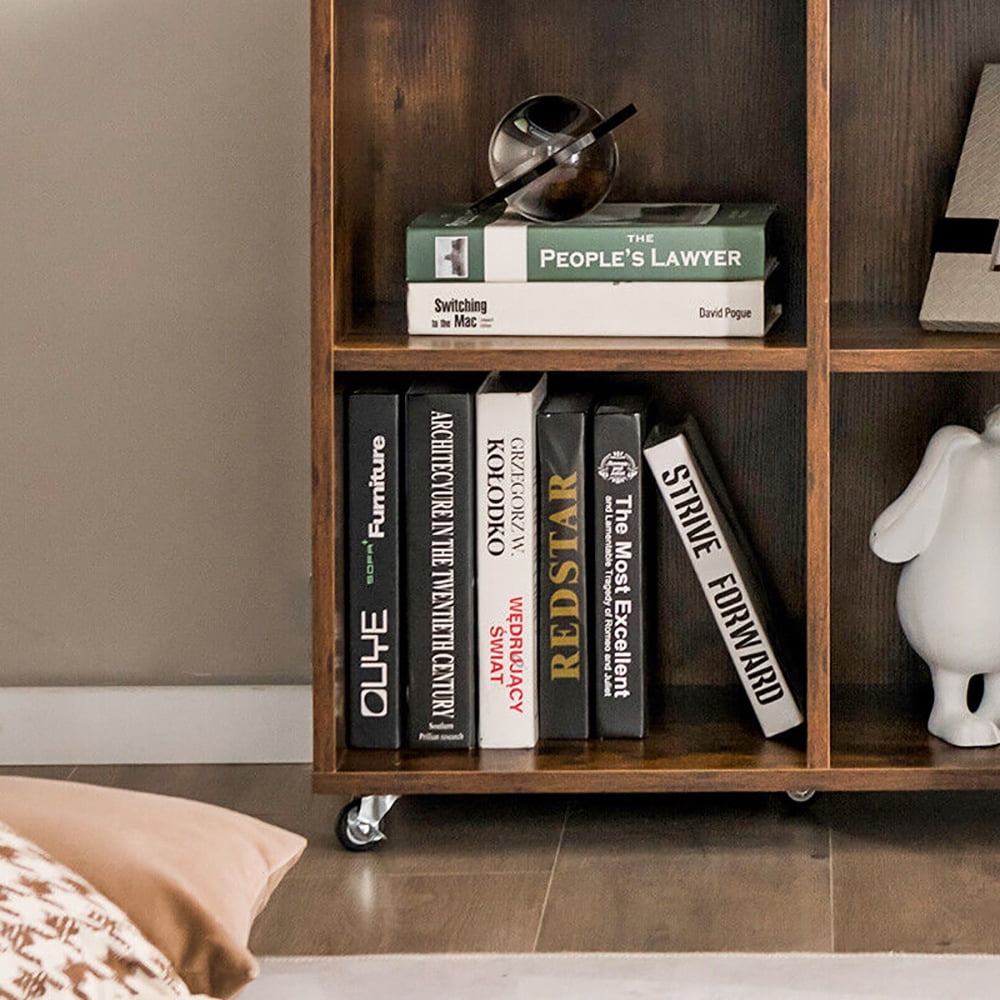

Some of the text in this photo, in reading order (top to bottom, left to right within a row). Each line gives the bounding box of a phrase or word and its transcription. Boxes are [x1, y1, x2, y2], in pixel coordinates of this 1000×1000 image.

[539, 248, 742, 268] PEOPLE'S LAWYER
[627, 234, 654, 243] THE
[434, 297, 487, 315] Switching
[454, 314, 477, 328] Mac
[699, 307, 752, 321] David Pogue
[368, 435, 386, 538] Furniture
[487, 438, 505, 556] KOŁODKO
[510, 437, 525, 532] GRZEGORZ
[604, 495, 614, 513] and
[432, 521, 455, 536] IN
[615, 494, 633, 535] The
[661, 464, 722, 559] STRIVE
[432, 538, 455, 567] THE
[614, 541, 633, 594] Most
[549, 471, 581, 681] REDSTAR
[603, 569, 614, 606] Tragedy
[432, 568, 455, 651] TWENTIETH
[604, 608, 613, 617] of
[489, 625, 505, 684] ŚWIAT
[506, 596, 524, 713] WĘDRUJĄCY
[604, 619, 613, 652] Romeo
[613, 600, 632, 698] Excellent
[707, 573, 784, 706] FORWARD
[604, 653, 613, 671] and
[432, 653, 455, 719] CENTURY
